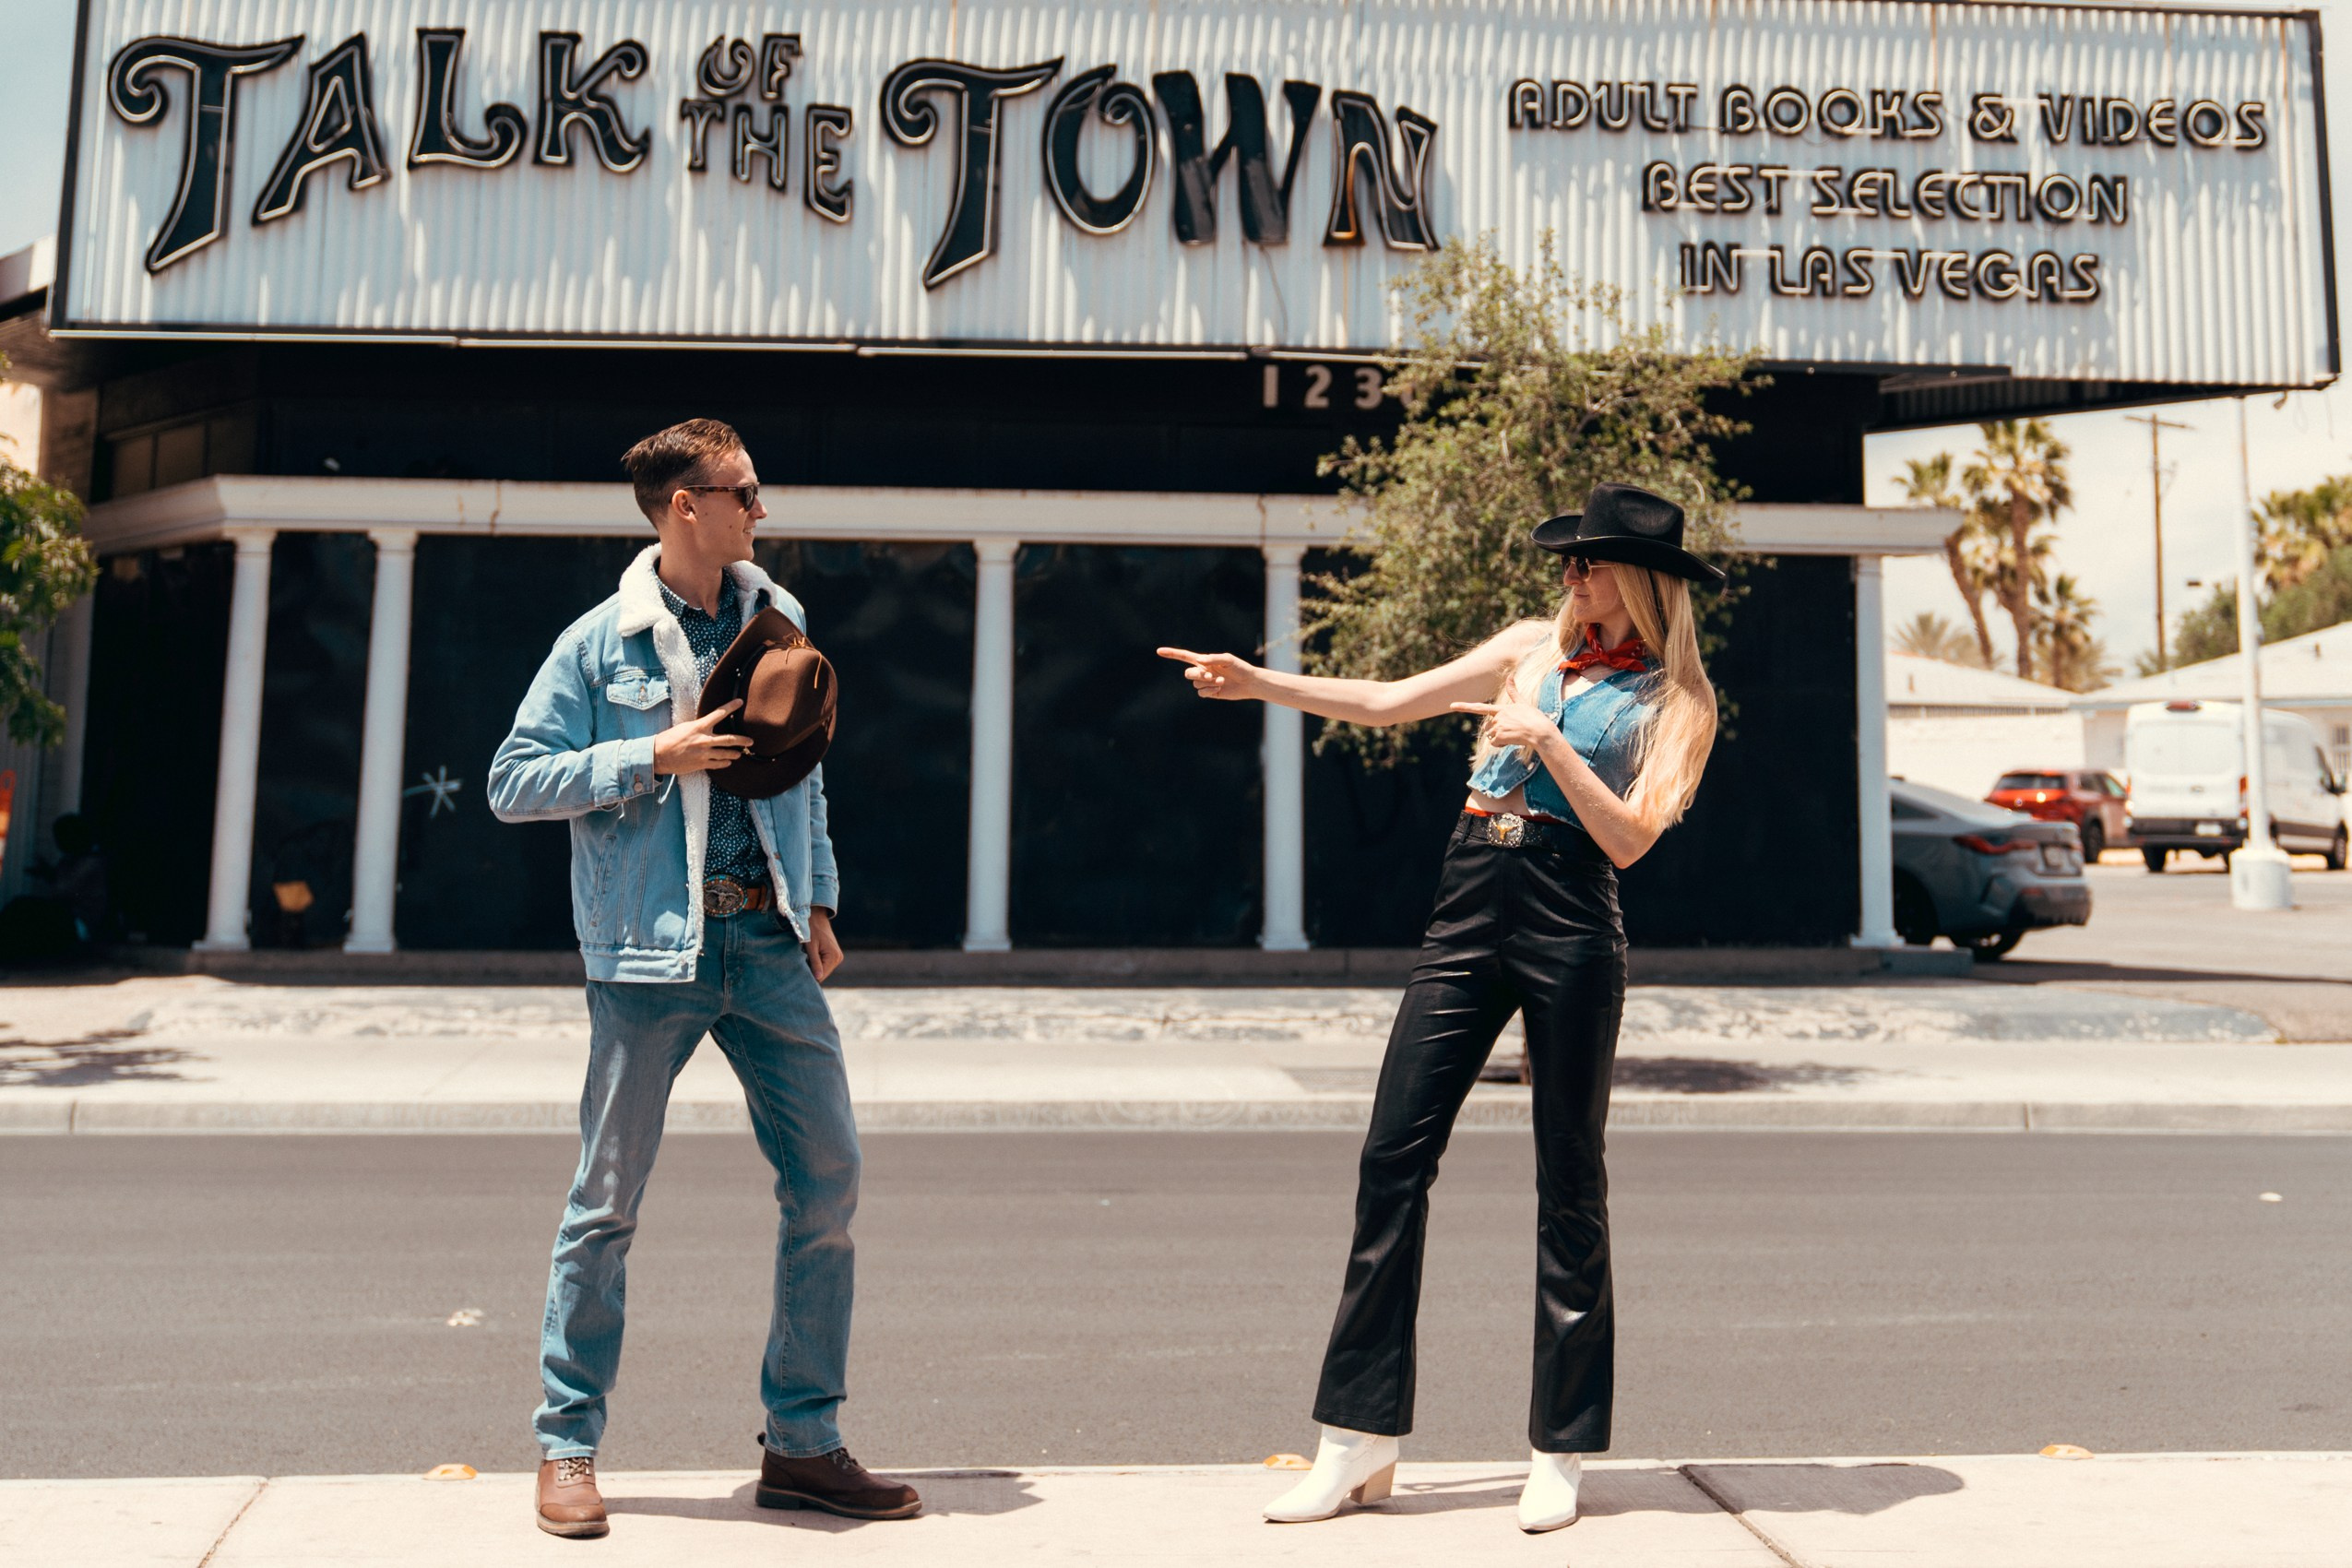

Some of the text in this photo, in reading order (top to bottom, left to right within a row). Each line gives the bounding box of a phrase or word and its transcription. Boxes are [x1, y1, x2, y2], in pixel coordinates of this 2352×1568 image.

[1509, 77, 2269, 150] ADULT BOOKS & VIDEOS
[108, 28, 1440, 291] TALK OF THE TOWN
[1642, 160, 2129, 227] BEST SELECTION
[1680, 243, 2103, 305] IN LAS VEGAS
